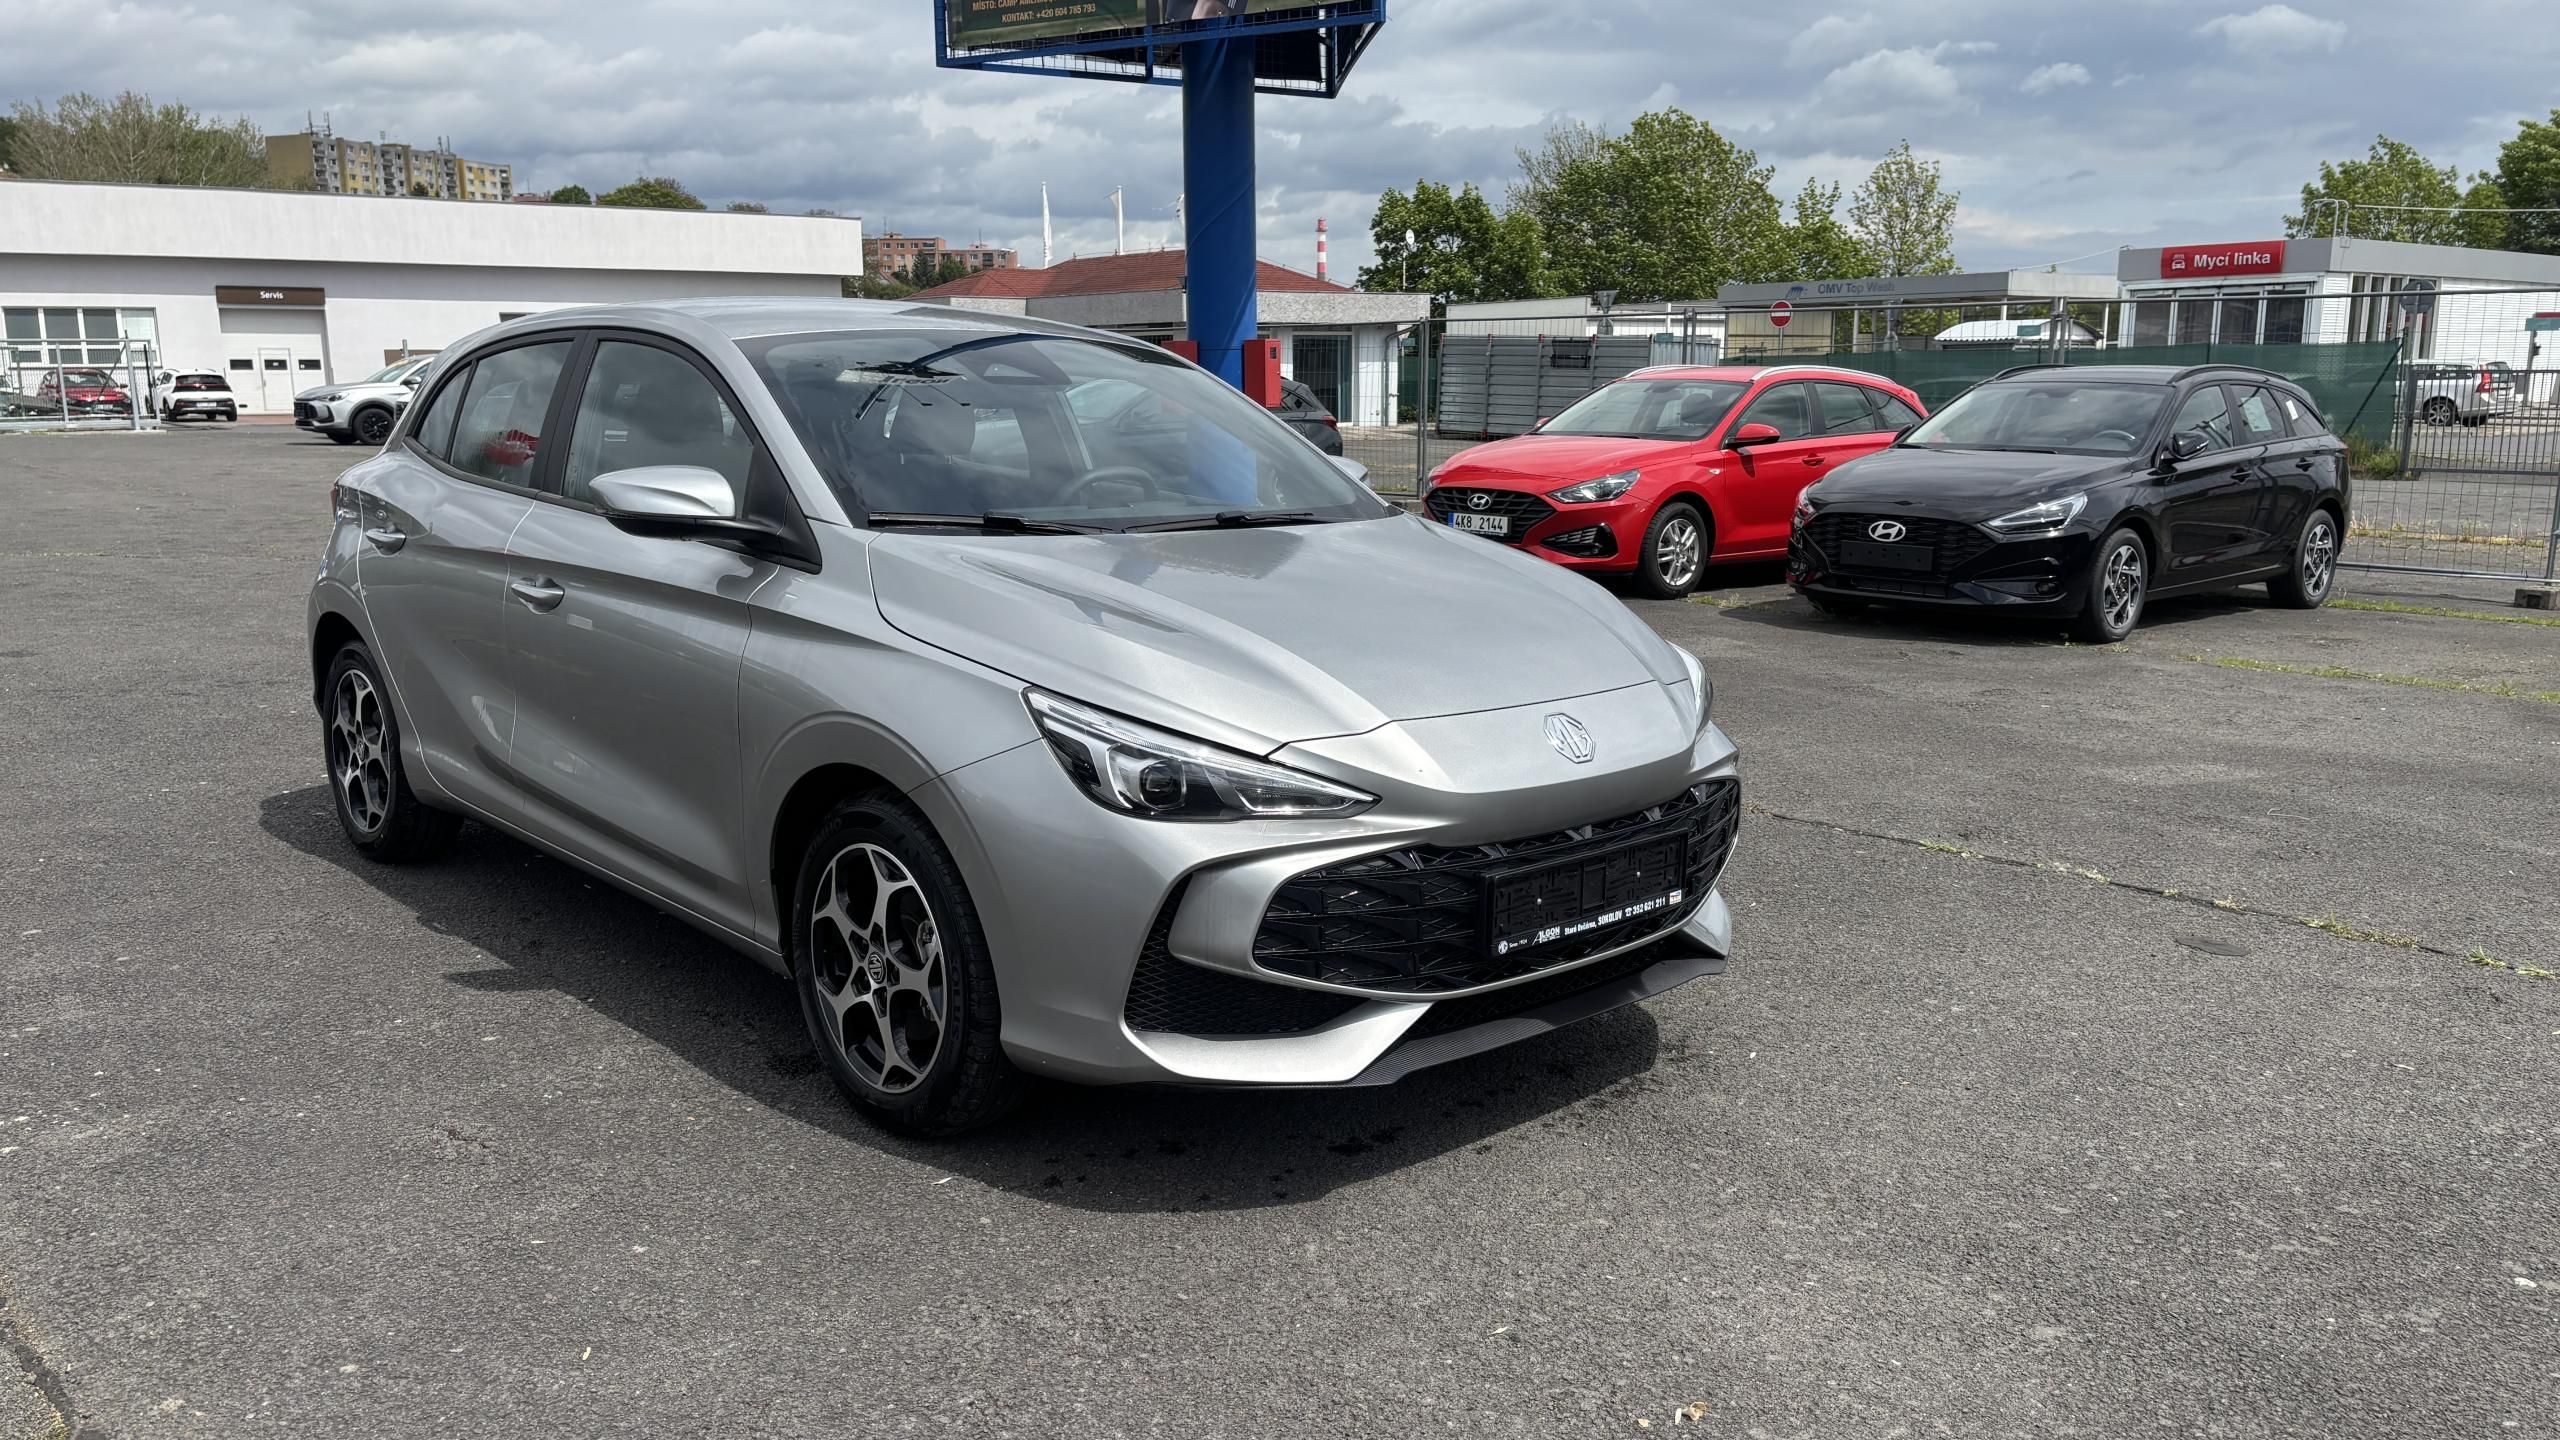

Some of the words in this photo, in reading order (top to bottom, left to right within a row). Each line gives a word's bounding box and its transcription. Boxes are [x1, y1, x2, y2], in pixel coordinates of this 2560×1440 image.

[1002, 11, 1035, 23] KONTAKT:
[1036, 8, 1054, 18] +420
[1055, 7, 1068, 16] 604
[1069, 5, 1081, 15] 785
[1083, 3, 1096, 13] 793
[2193, 252, 2230, 270] Mycí
[2234, 251, 2271, 266] linka
[260, 291, 284, 299] Servis
[1817, 284, 1843, 294] OMV
[1455, 515, 1472, 528] 4K8
[1479, 517, 1503, 531] 2144
[1598, 909, 1622, 926] SOKOLOV
[1632, 903, 1644, 915] 352
[1655, 896, 1666, 908] 211
[1532, 925, 1561, 946] ALGON
